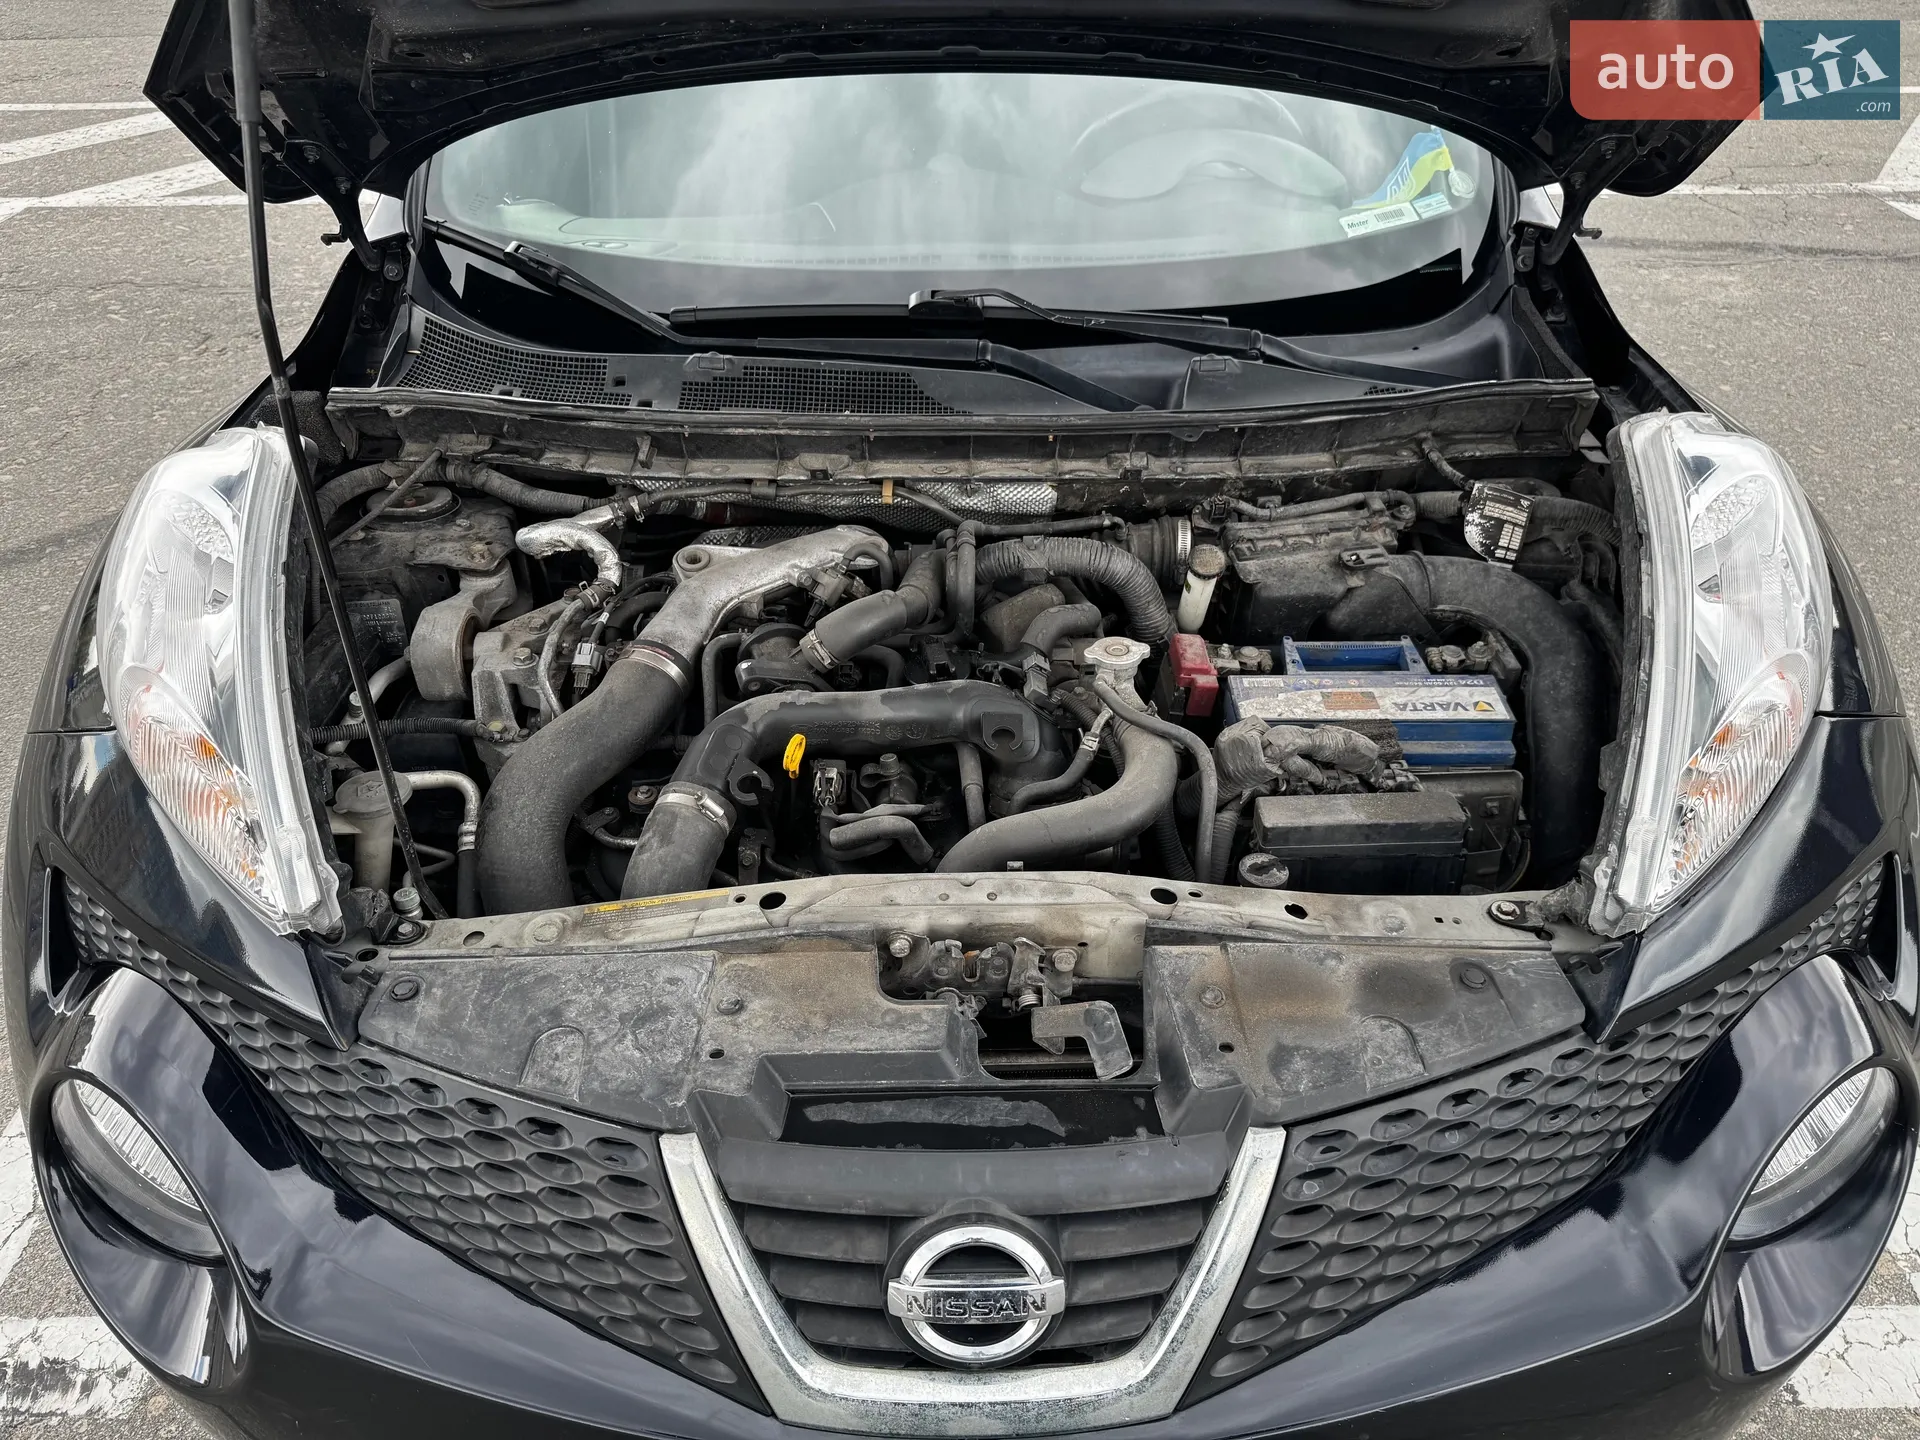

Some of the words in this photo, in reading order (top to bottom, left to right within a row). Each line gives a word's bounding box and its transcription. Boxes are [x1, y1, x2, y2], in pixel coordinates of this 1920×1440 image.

[1347, 219, 1369, 230] Mister
[1391, 702, 1470, 712] VARTA
[631, 900, 656, 908] CAUTION
[907, 1292, 1047, 1318] NISSAN
